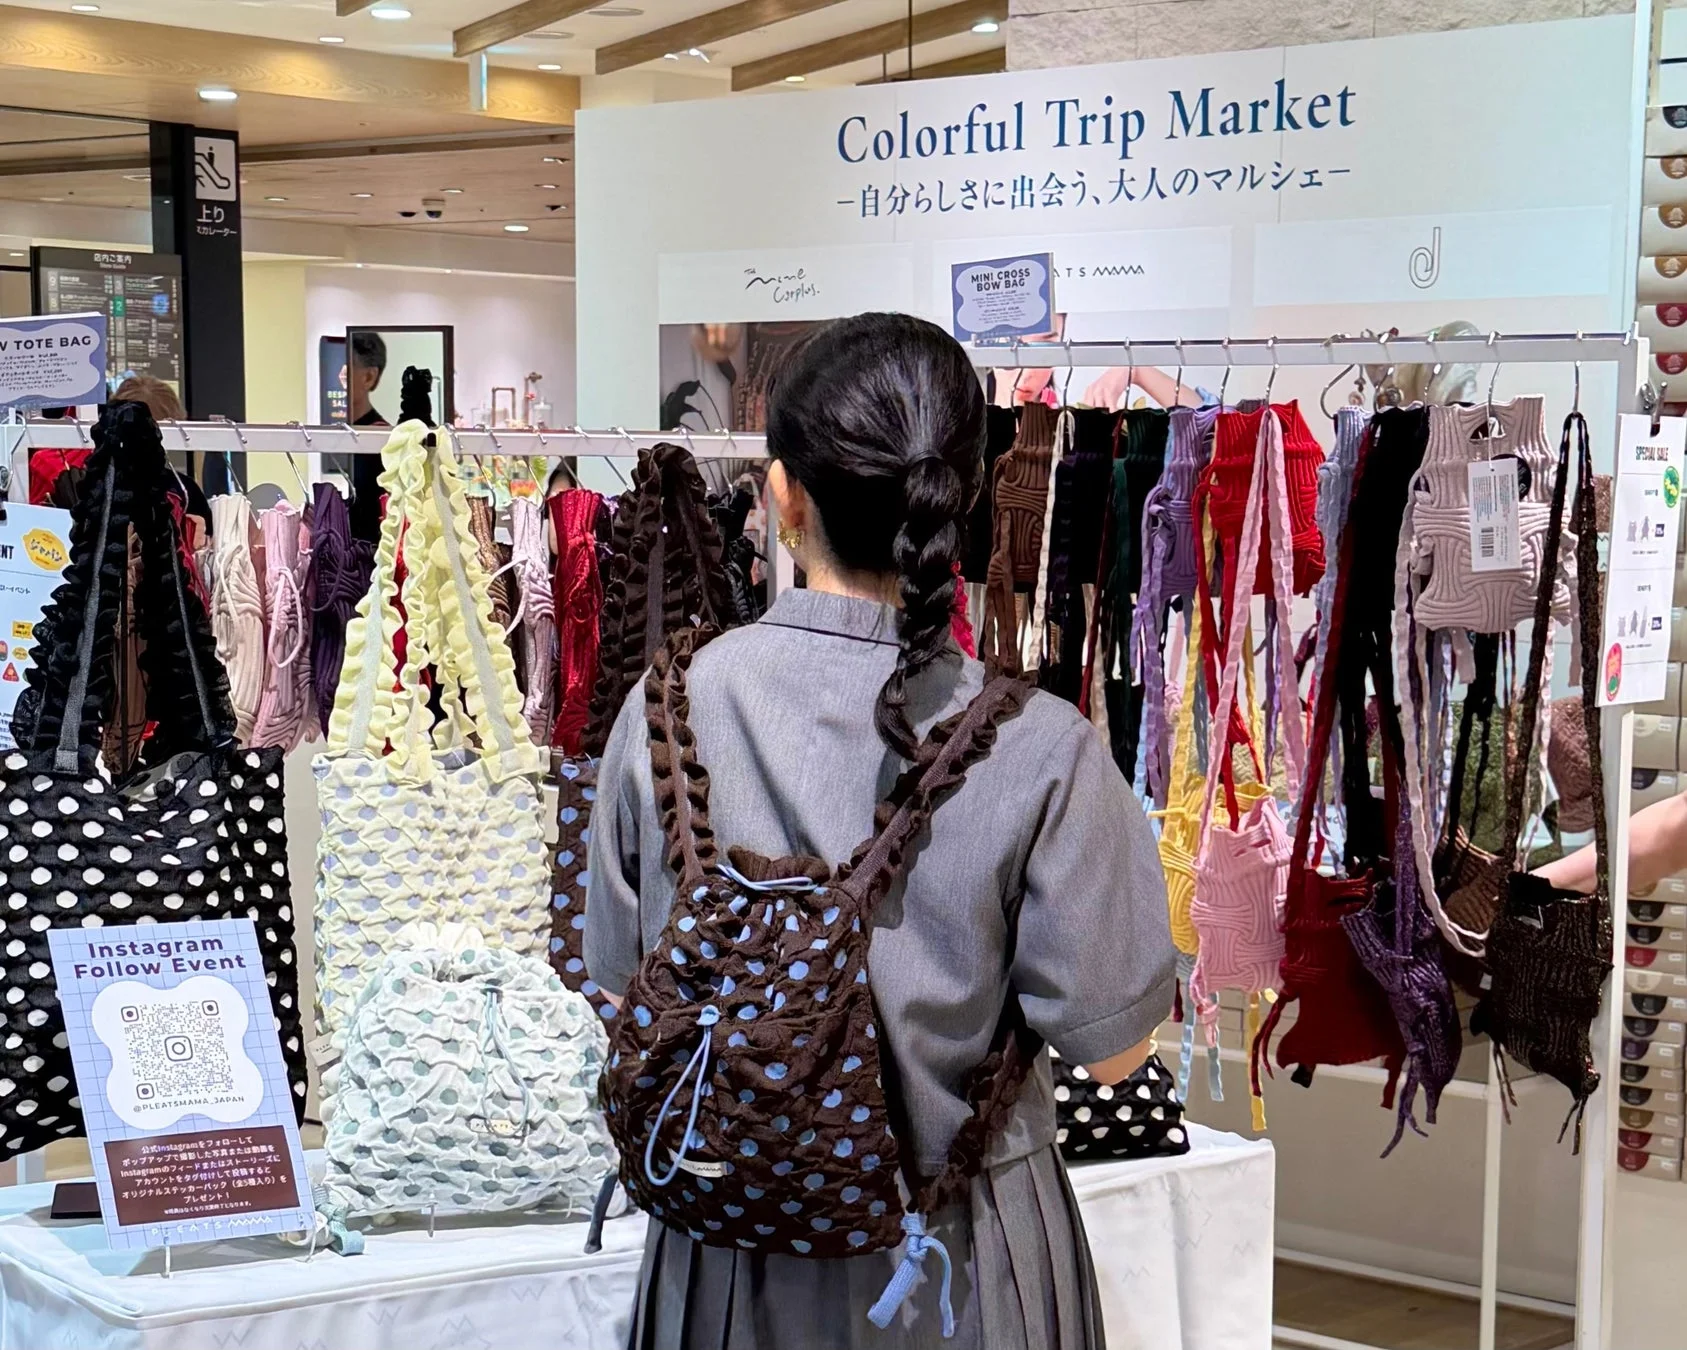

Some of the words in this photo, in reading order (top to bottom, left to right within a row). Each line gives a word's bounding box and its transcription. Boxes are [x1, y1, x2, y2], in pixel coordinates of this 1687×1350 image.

[838, 101, 1026, 163] Colorful
[1045, 94, 1145, 161] Trip
[1164, 77, 1356, 140] Market
[196, 204, 225, 223] 上り
[971, 272, 994, 284] MINI
[997, 268, 1031, 281] CROSS
[976, 281, 1001, 292] BOW
[1004, 278, 1026, 289] BAG
[116, 300, 123, 312] 2
[14, 338, 53, 351] TOTE
[60, 335, 91, 348] BAG
[88, 938, 223, 959] Instagram
[74, 961, 161, 979] Follow
[172, 954, 246, 973] Event
[133, 1096, 245, 1113] @PLEATSMAMA_JAPAN
